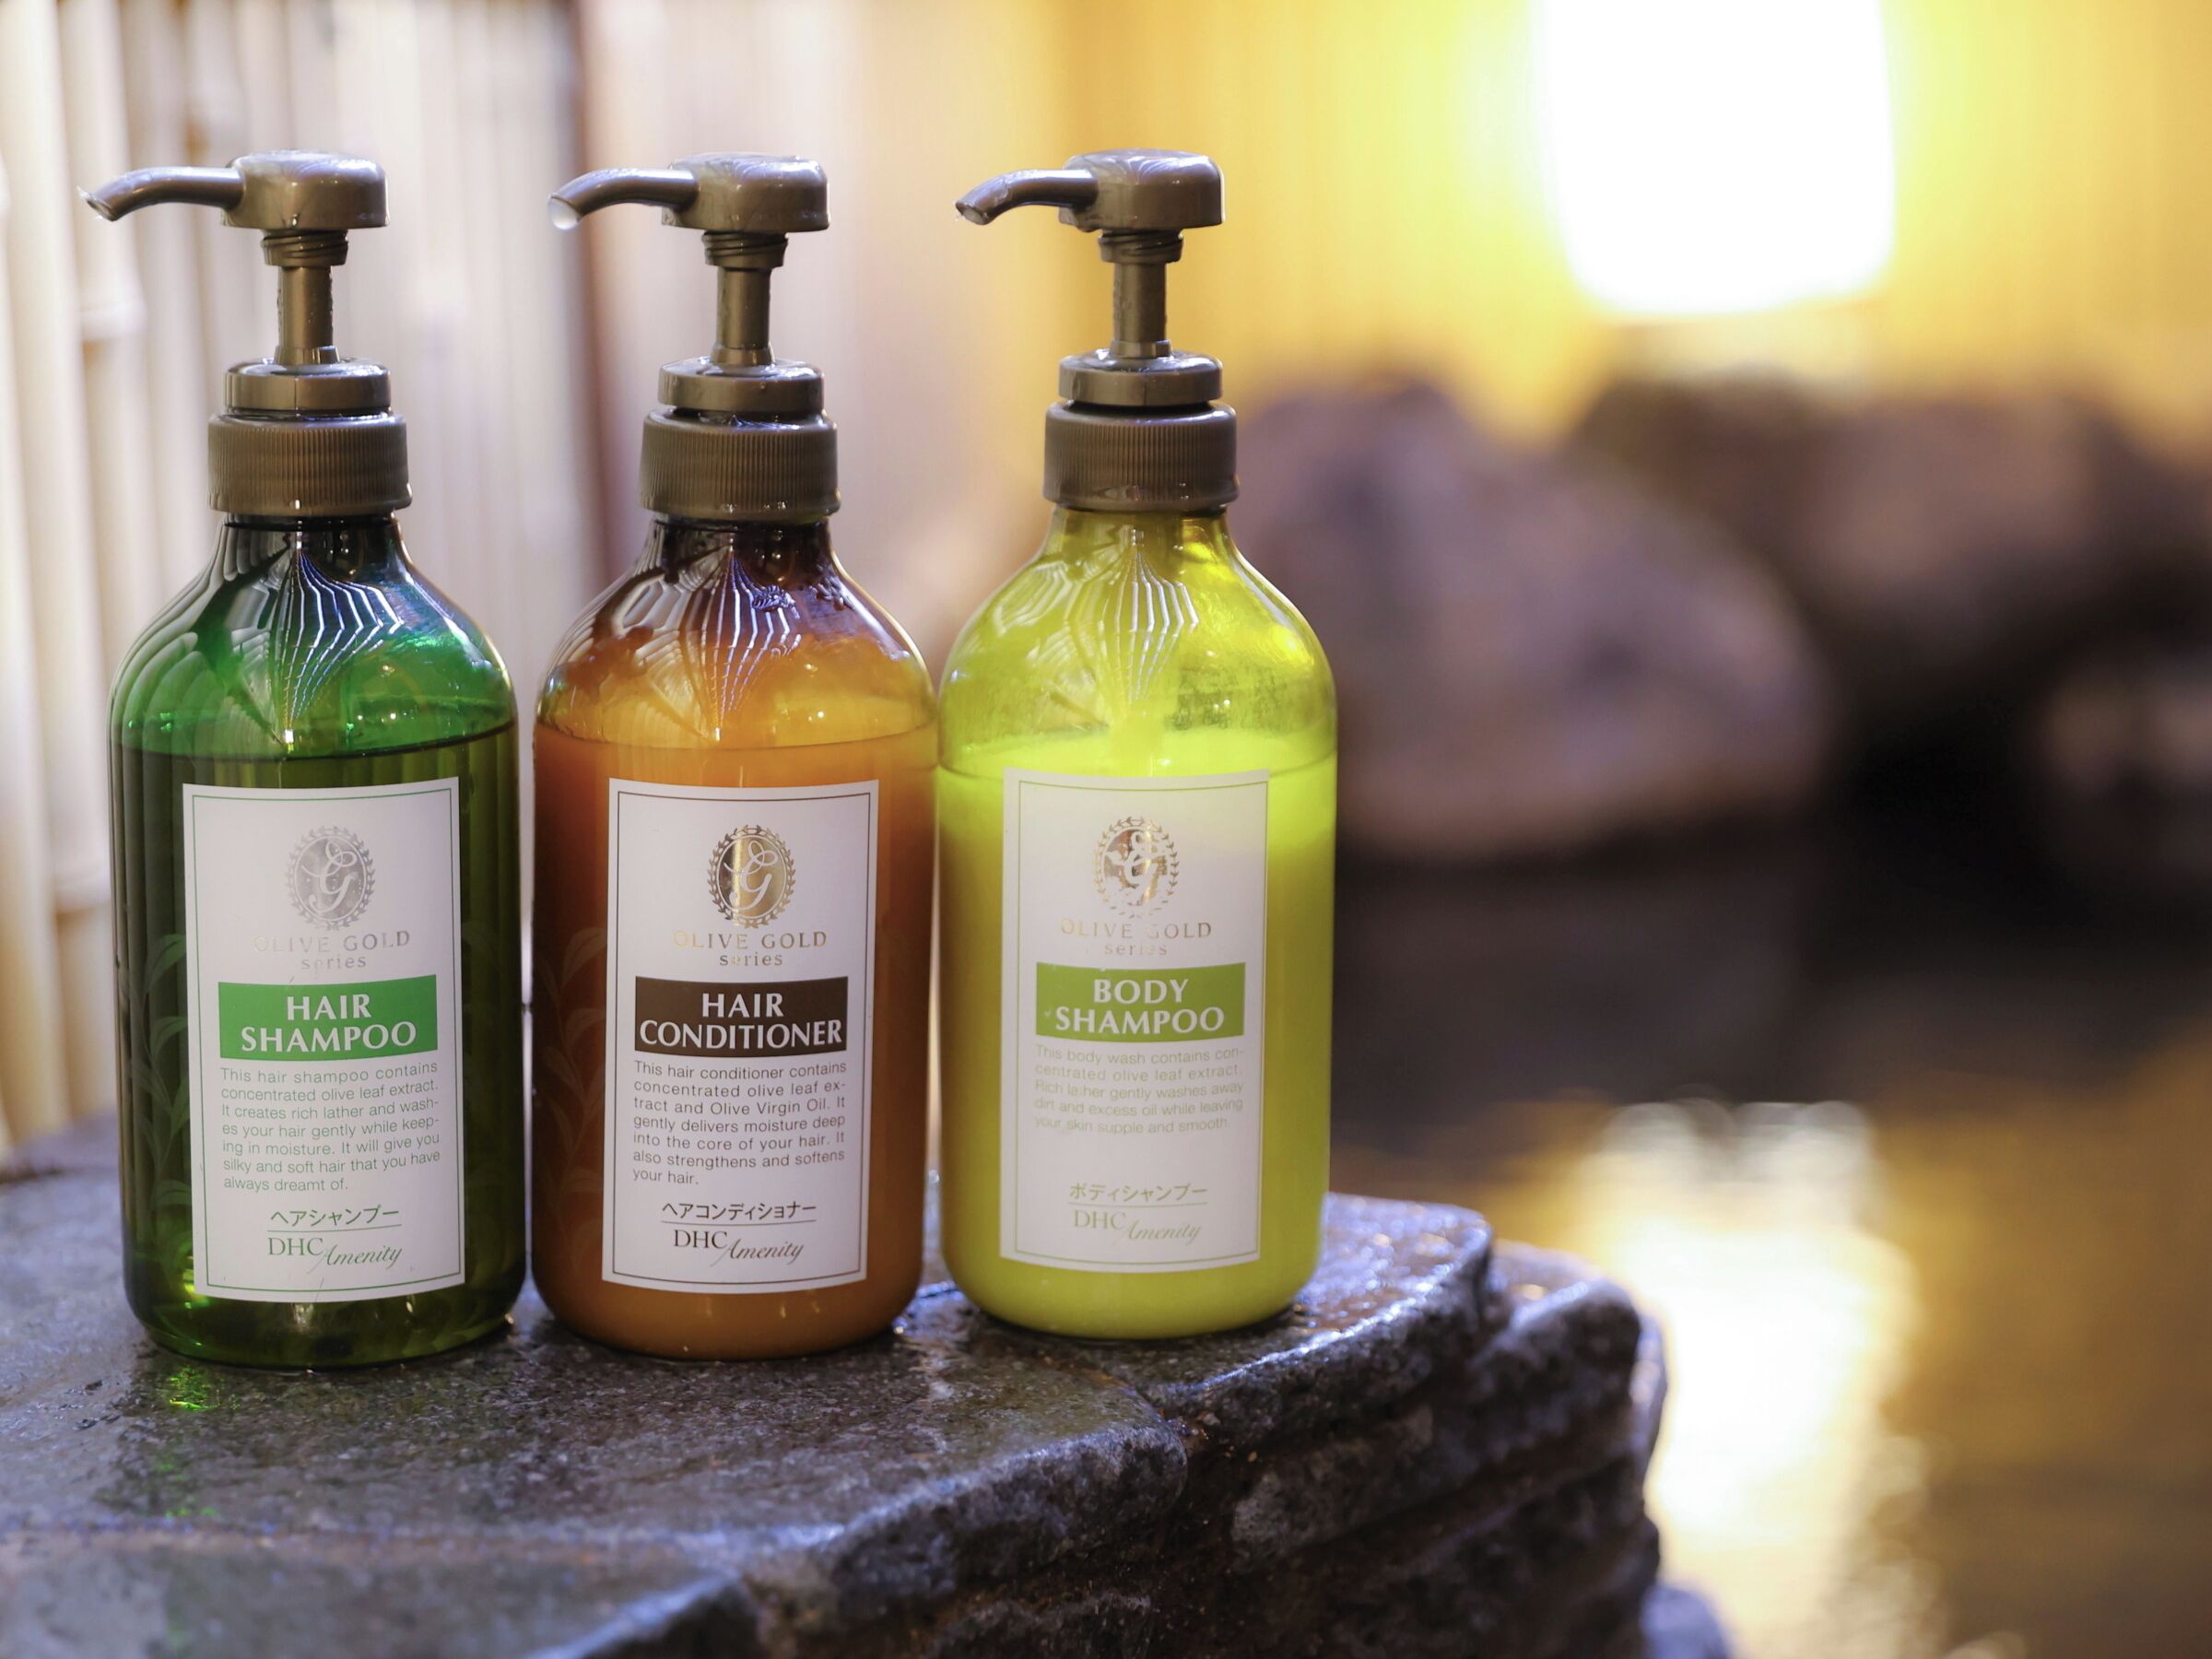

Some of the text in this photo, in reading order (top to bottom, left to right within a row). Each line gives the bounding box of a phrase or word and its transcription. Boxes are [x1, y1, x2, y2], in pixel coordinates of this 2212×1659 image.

[1061, 918, 1133, 938] OLIVE
[343, 930, 410, 951] GOLD
[674, 930, 827, 949] OLIVE GOLD
[720, 951, 782, 967] series
[1094, 979, 1189, 1004] BODY
[287, 994, 371, 1020] HAIR
[702, 993, 783, 1018] HAIR
[1055, 1006, 1224, 1034] SHAMPOO
[241, 1021, 416, 1053] SHAMPOO
[640, 1019, 842, 1050] CONDITIONER
[1035, 1044, 1243, 1065] This body wash contains con-
[220, 1061, 438, 1085] This hair shampoo contains
[634, 1060, 847, 1080] This hair conditioner contains
[1035, 1065, 1106, 1080] centrated
[1112, 1069, 1149, 1081] olive
[1155, 1068, 1182, 1080] leaf
[221, 1079, 439, 1101] concentrated olive leaf extract.
[634, 1080, 846, 1098] concentrated olive leaf ex-
[1036, 1080, 1063, 1094] Rich
[1110, 1086, 1151, 1101] gently
[1156, 1086, 1207, 1098] washes
[1211, 1082, 1243, 1095] away
[222, 1098, 439, 1119] It creates rich lather and wash-
[634, 1096, 845, 1116] tract and Olive Virgin Oil. It
[1060, 1102, 1084, 1113] and
[1142, 1104, 1157, 1116] oil
[1161, 1103, 1197, 1115] while
[1201, 1099, 1243, 1112] leaving
[222, 1116, 439, 1139] es your hair gently while keep-
[633, 1114, 845, 1133] gently delivers moisture deep
[1065, 1121, 1092, 1132] skin
[1148, 1121, 1174, 1133] and
[223, 1134, 439, 1156] ing in moisture. It will give you
[633, 1132, 845, 1152] into the core of your hair. It
[223, 1150, 440, 1174] silky and soft hair that you have
[633, 1150, 845, 1171] also strengthens and softens
[224, 1177, 348, 1193] always dreamt of.
[632, 1169, 699, 1185] your hair.
[271, 1204, 399, 1227] ヘアシャンプー
[662, 1201, 817, 1220] ヘアコンディショナー
[1074, 1210, 1126, 1230] DHC
[267, 1237, 324, 1256] DHC
[674, 1230, 804, 1267] DHC Amenity
